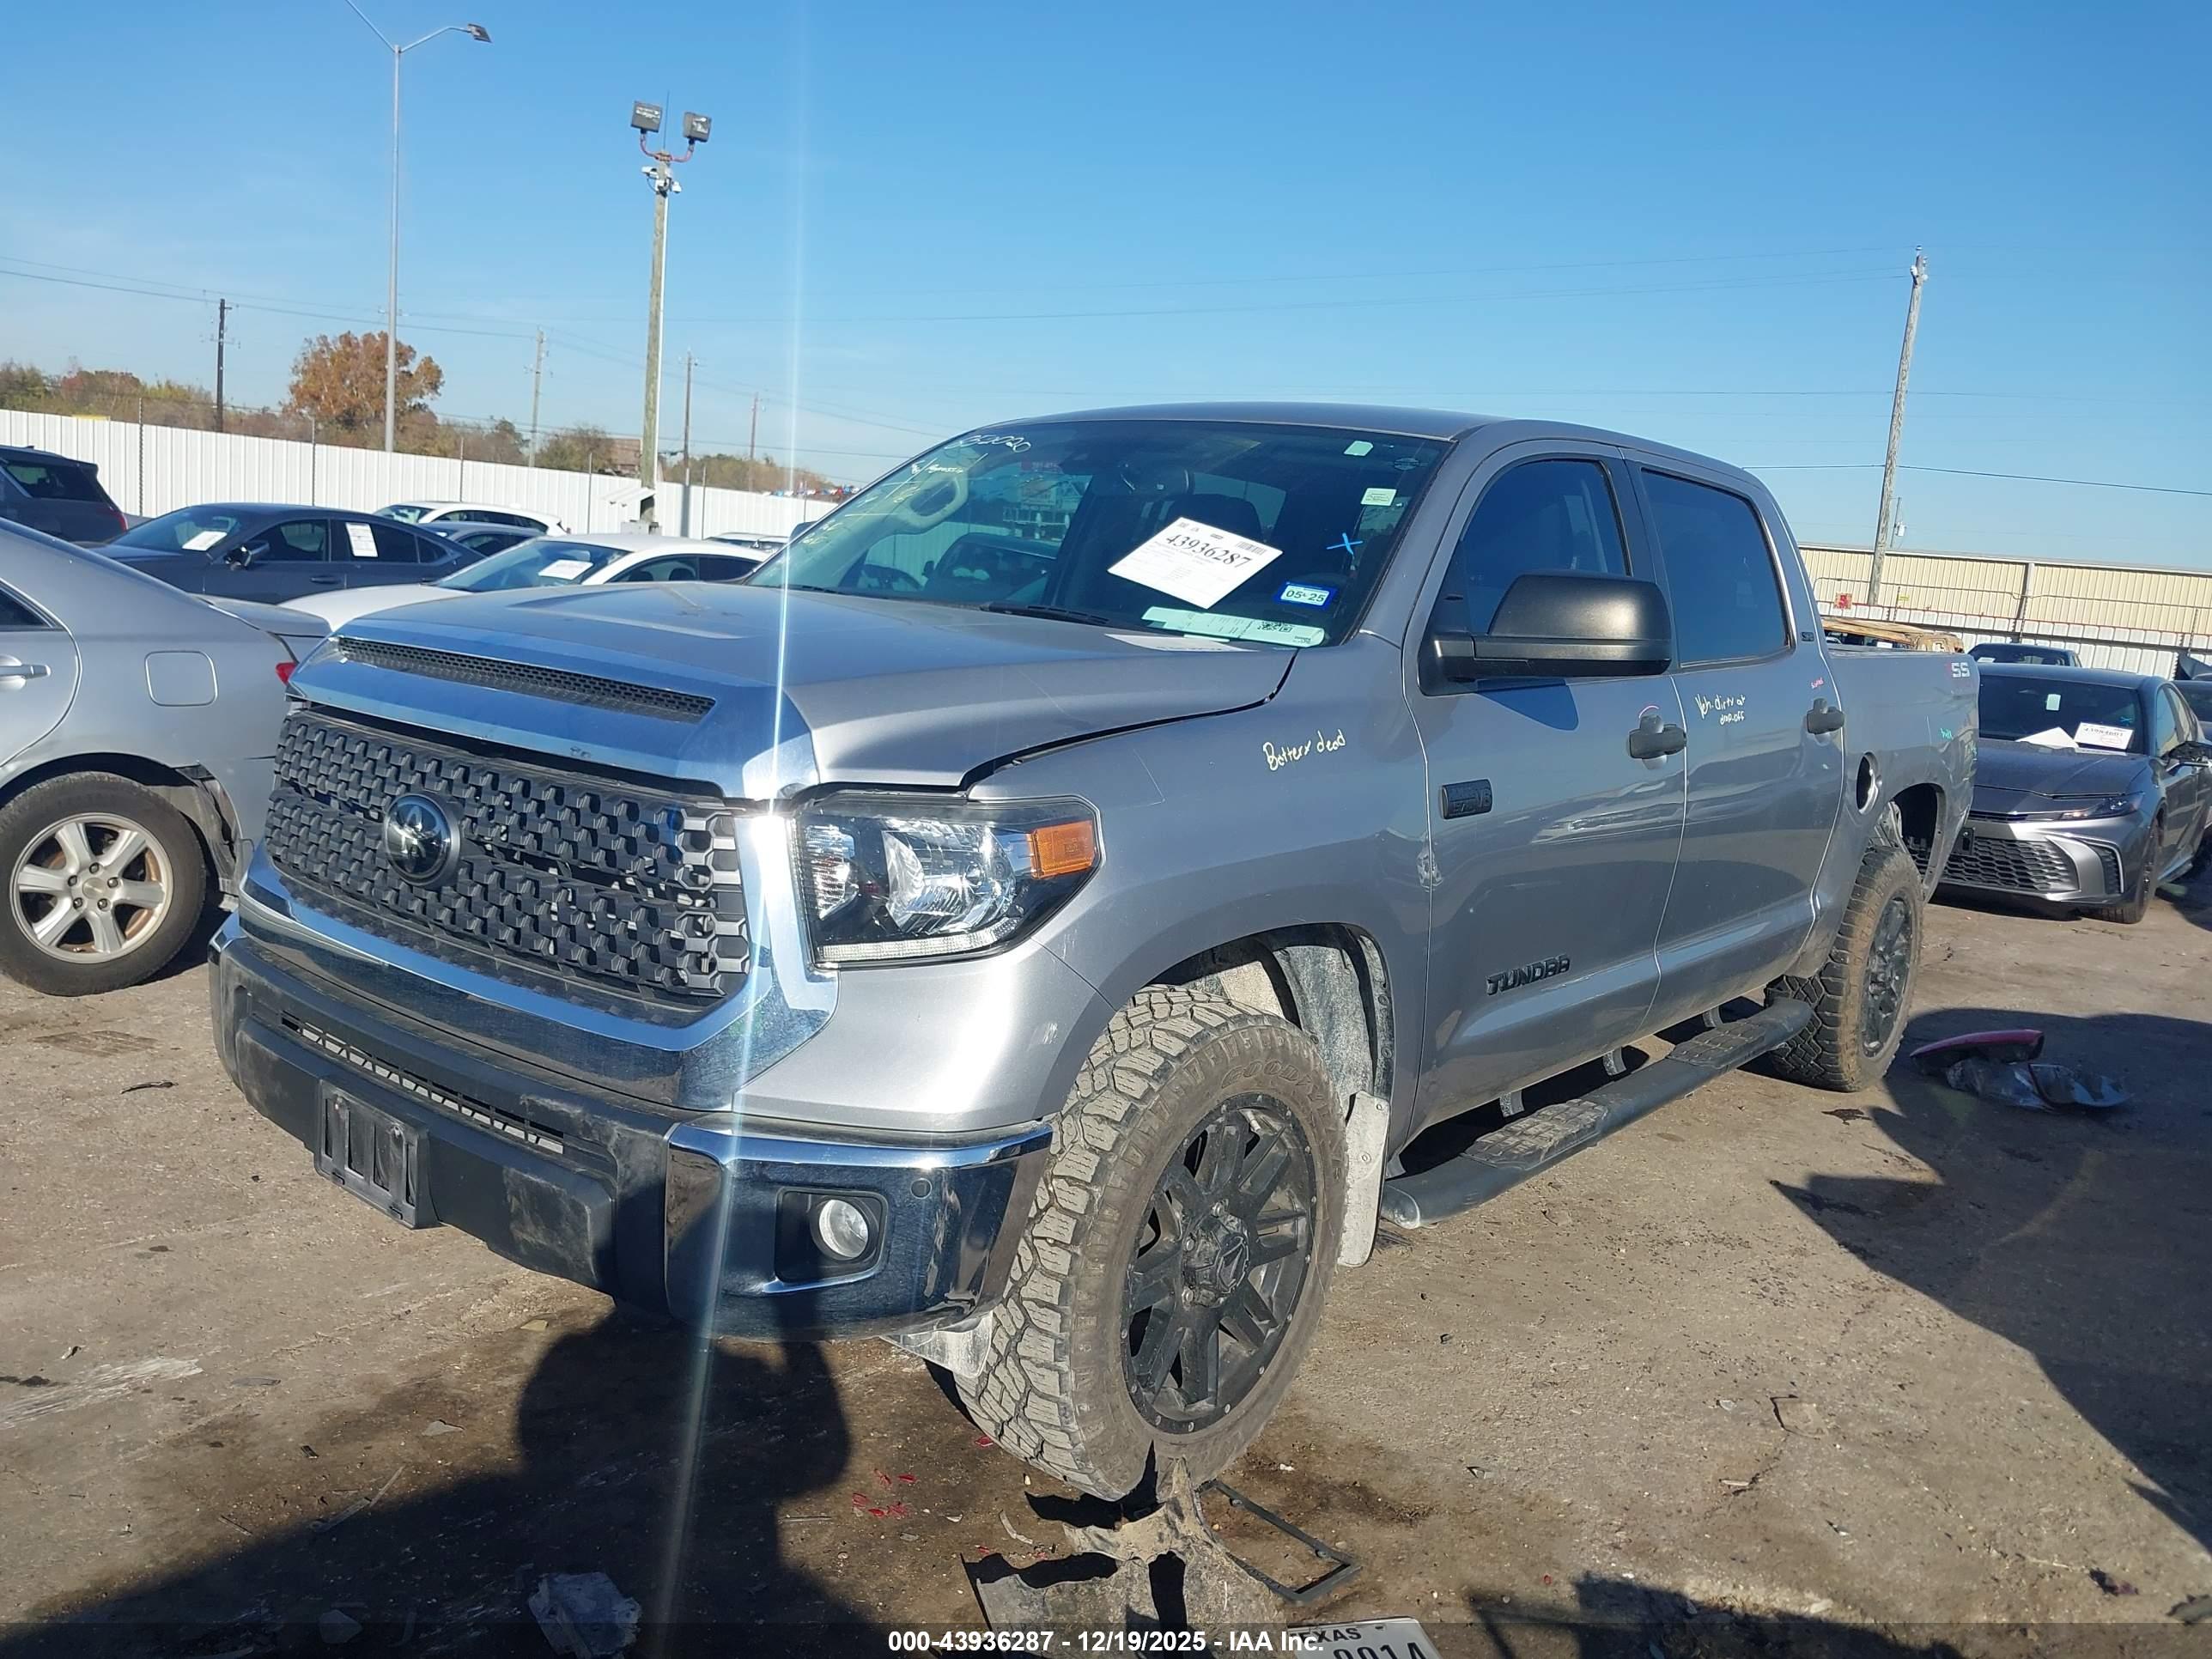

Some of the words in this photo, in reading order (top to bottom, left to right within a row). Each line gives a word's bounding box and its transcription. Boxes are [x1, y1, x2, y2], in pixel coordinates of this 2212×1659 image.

[1166, 534, 1252, 568] 43936287
[1316, 729, 1346, 752] dead
[1486, 952, 1571, 996] TUNDRA
